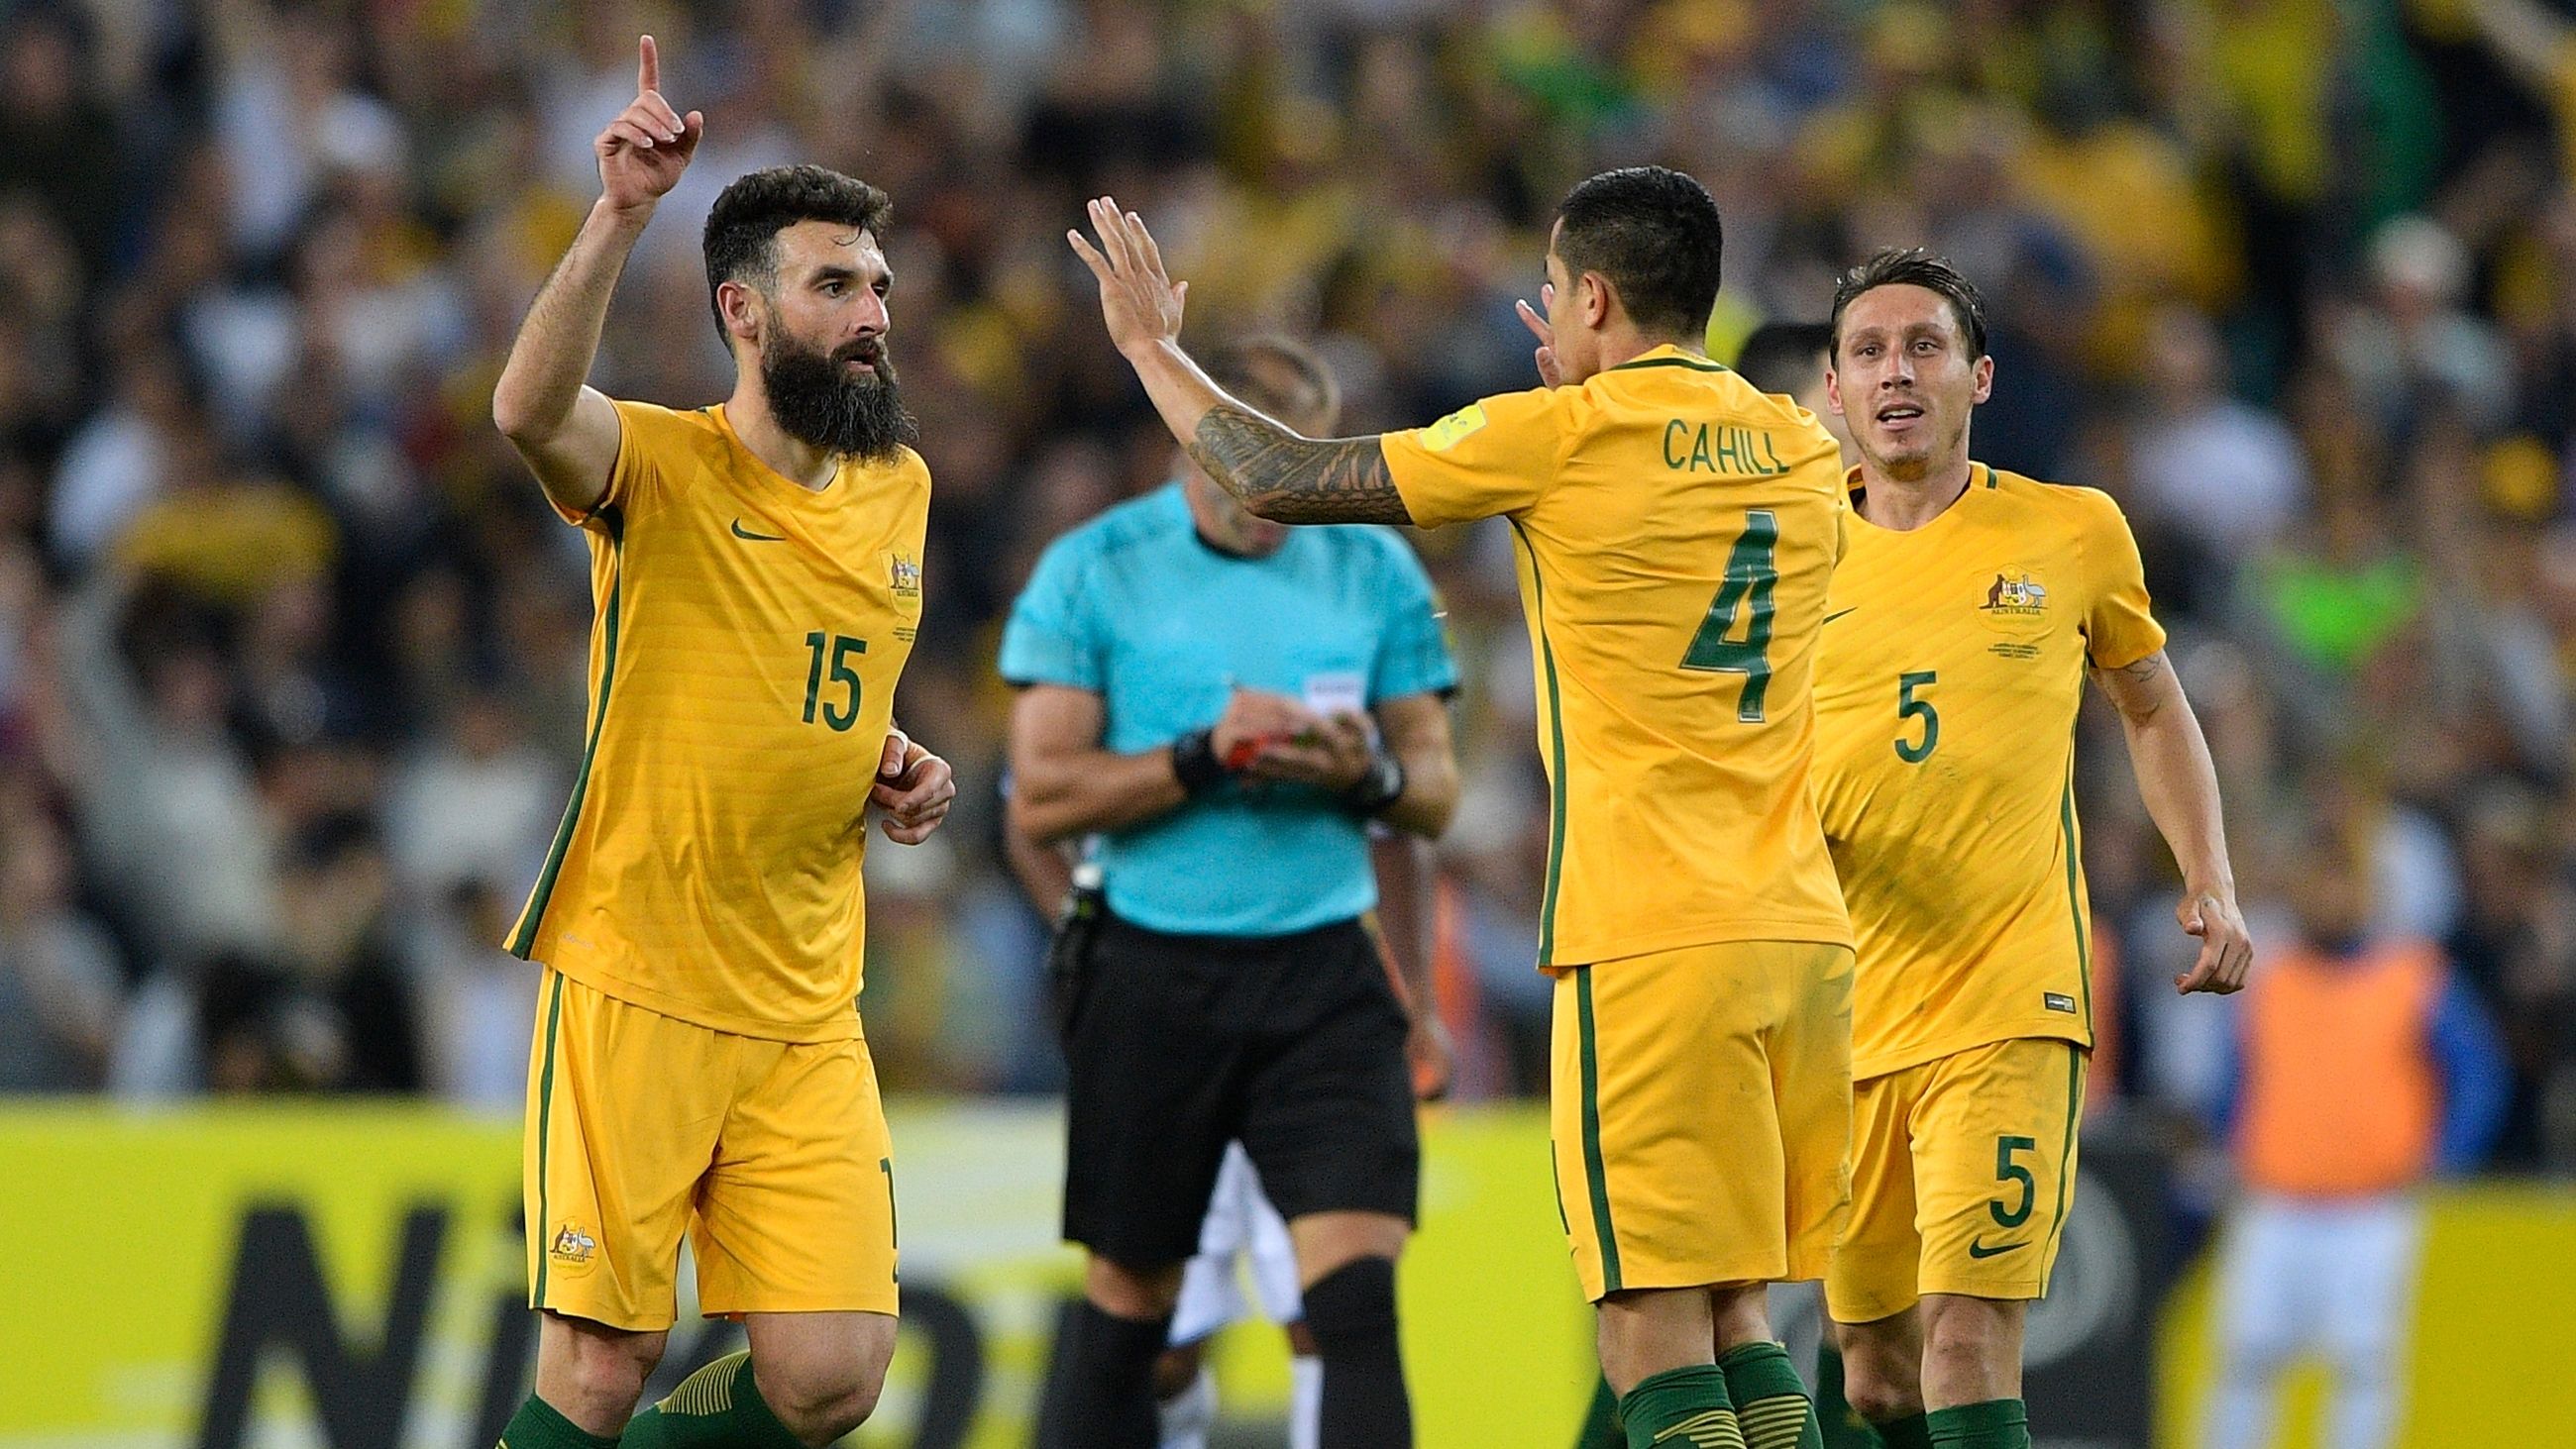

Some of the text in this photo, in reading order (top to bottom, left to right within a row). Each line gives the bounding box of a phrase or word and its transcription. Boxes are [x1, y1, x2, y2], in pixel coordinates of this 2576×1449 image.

[1664, 418, 1791, 474] CAHILL
[1678, 508, 1780, 724] 4
[803, 631, 867, 732] 15
[1894, 670, 1939, 764] 5
[1989, 1135, 2035, 1228] 5
